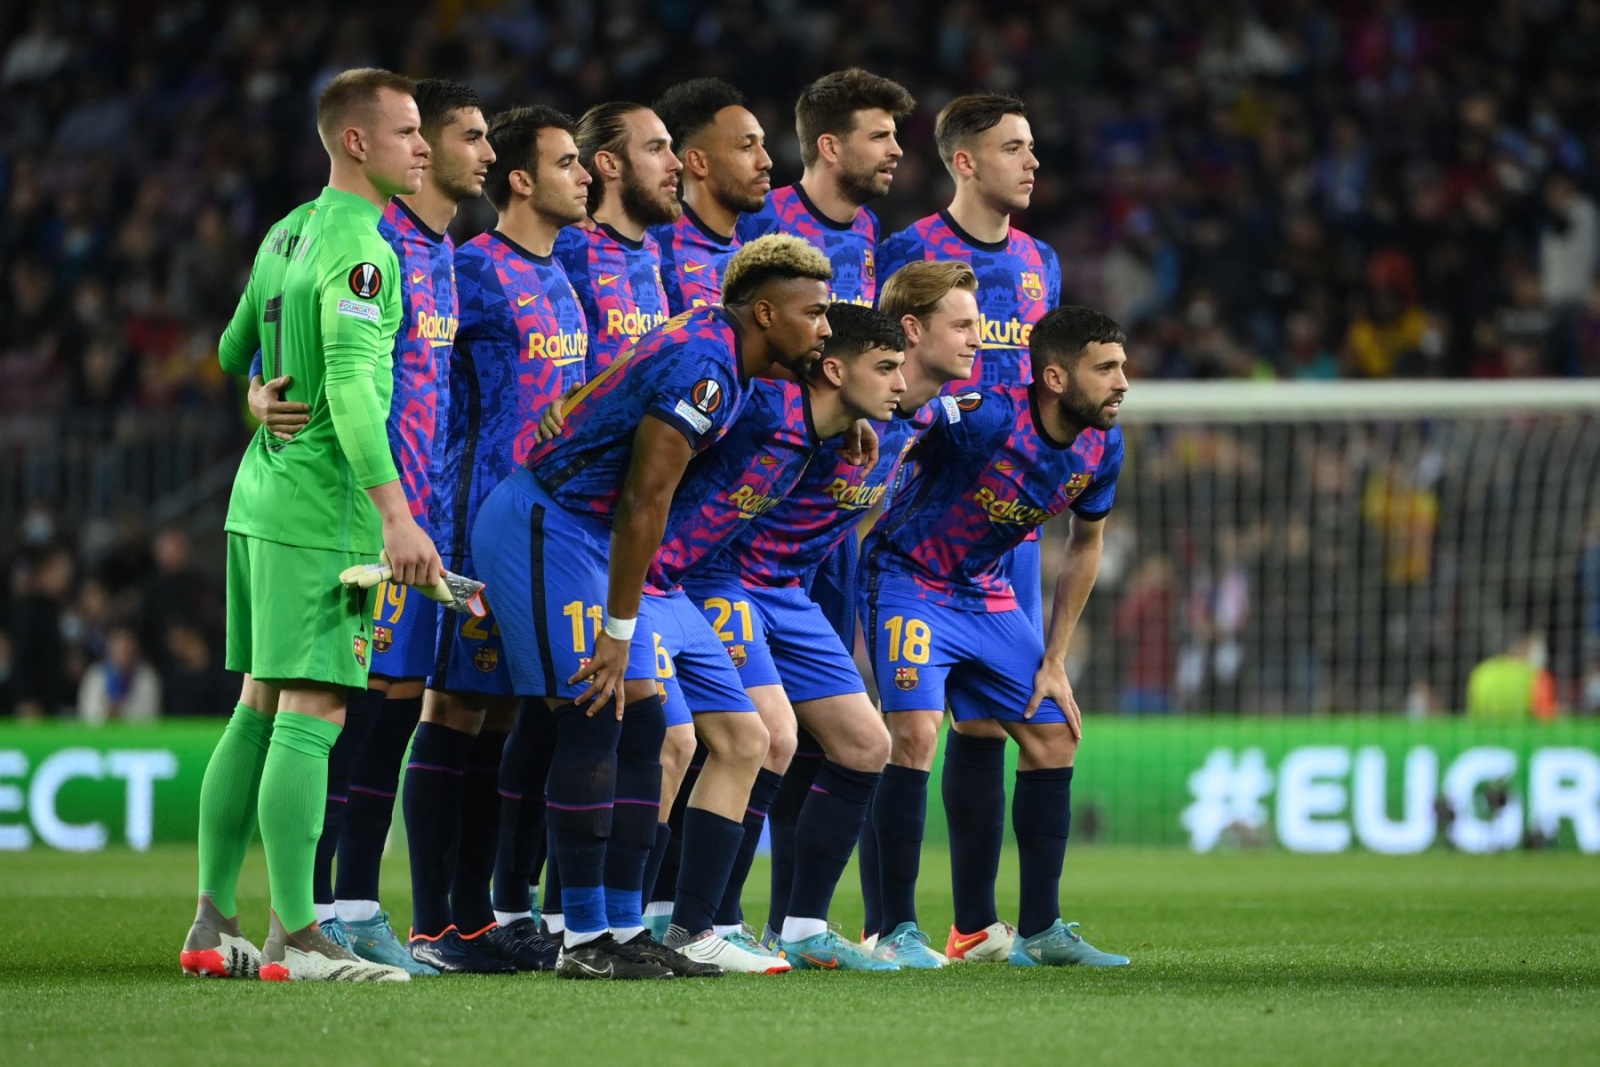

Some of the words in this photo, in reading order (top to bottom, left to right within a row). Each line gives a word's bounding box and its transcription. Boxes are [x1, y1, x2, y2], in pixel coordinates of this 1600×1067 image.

[976, 313, 1033, 346] kute
[373, 580, 407, 624] 19
[704, 597, 754, 642] 21
[563, 601, 603, 653] 11
[884, 616, 931, 664] 18
